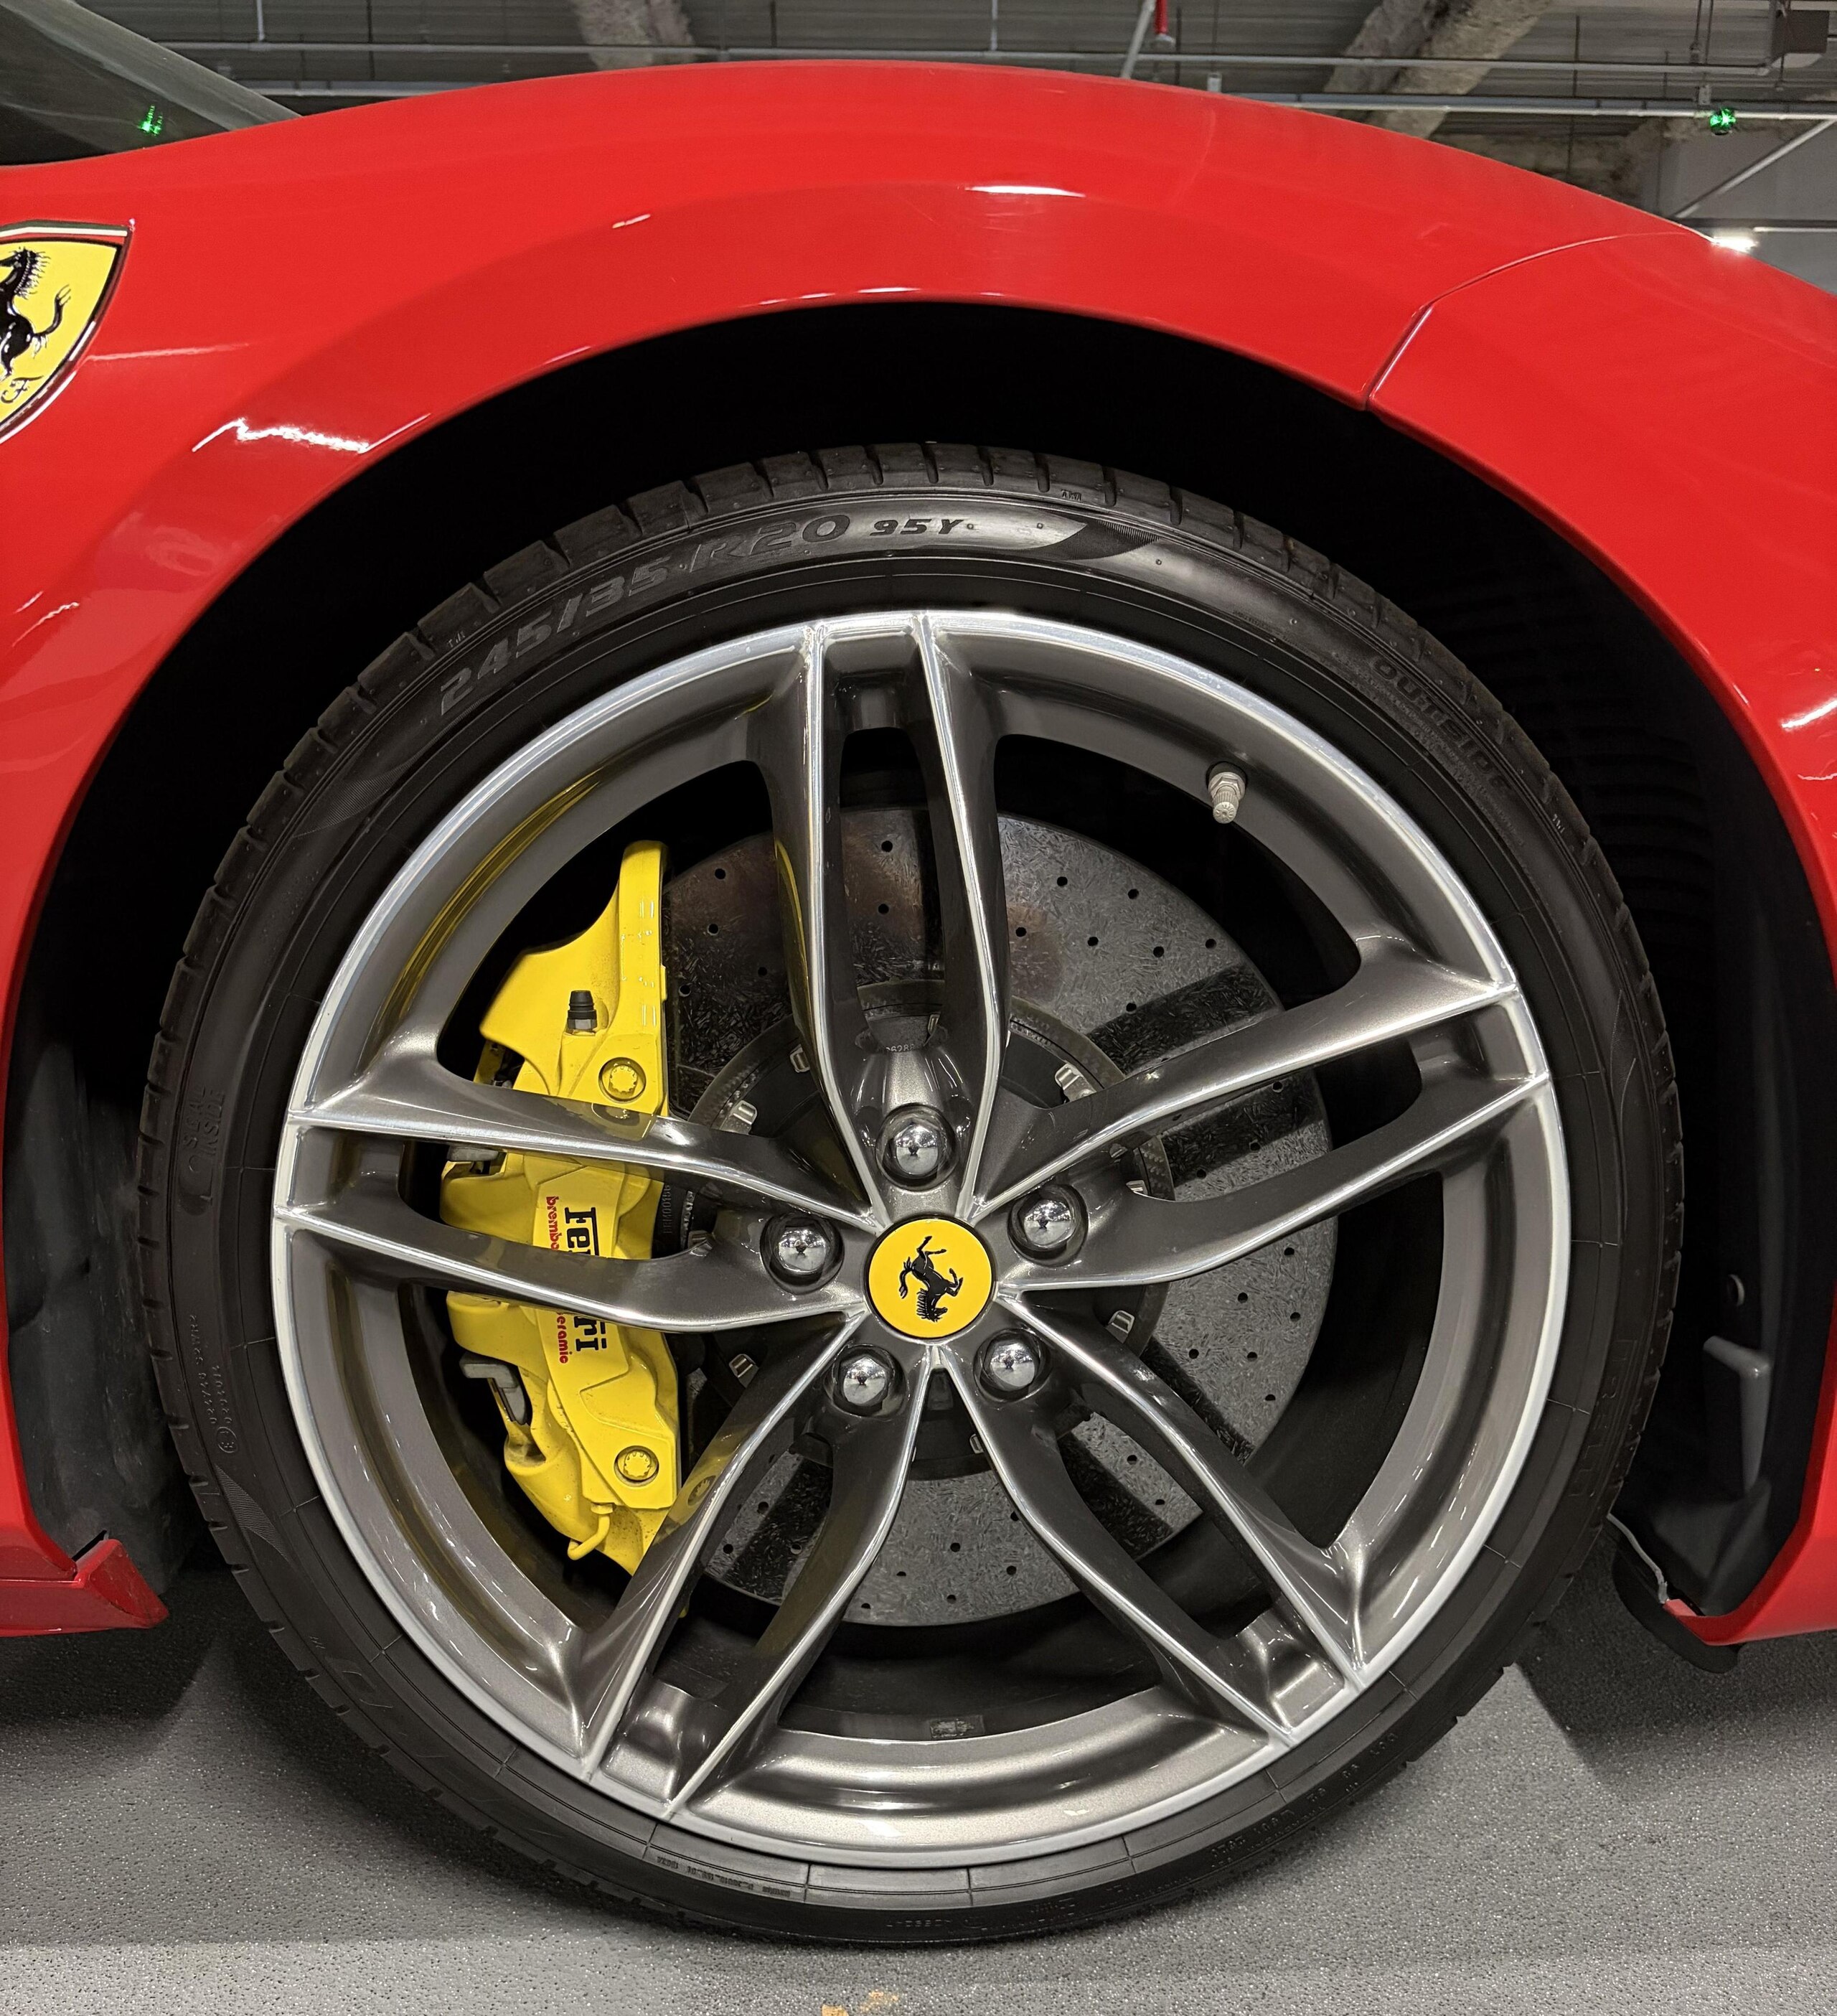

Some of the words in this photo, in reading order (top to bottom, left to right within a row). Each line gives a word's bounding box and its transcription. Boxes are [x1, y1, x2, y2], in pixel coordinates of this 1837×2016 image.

[441, 555, 672, 716] 245/35
[689, 514, 850, 573] R20
[869, 518, 964, 537] 95Y
